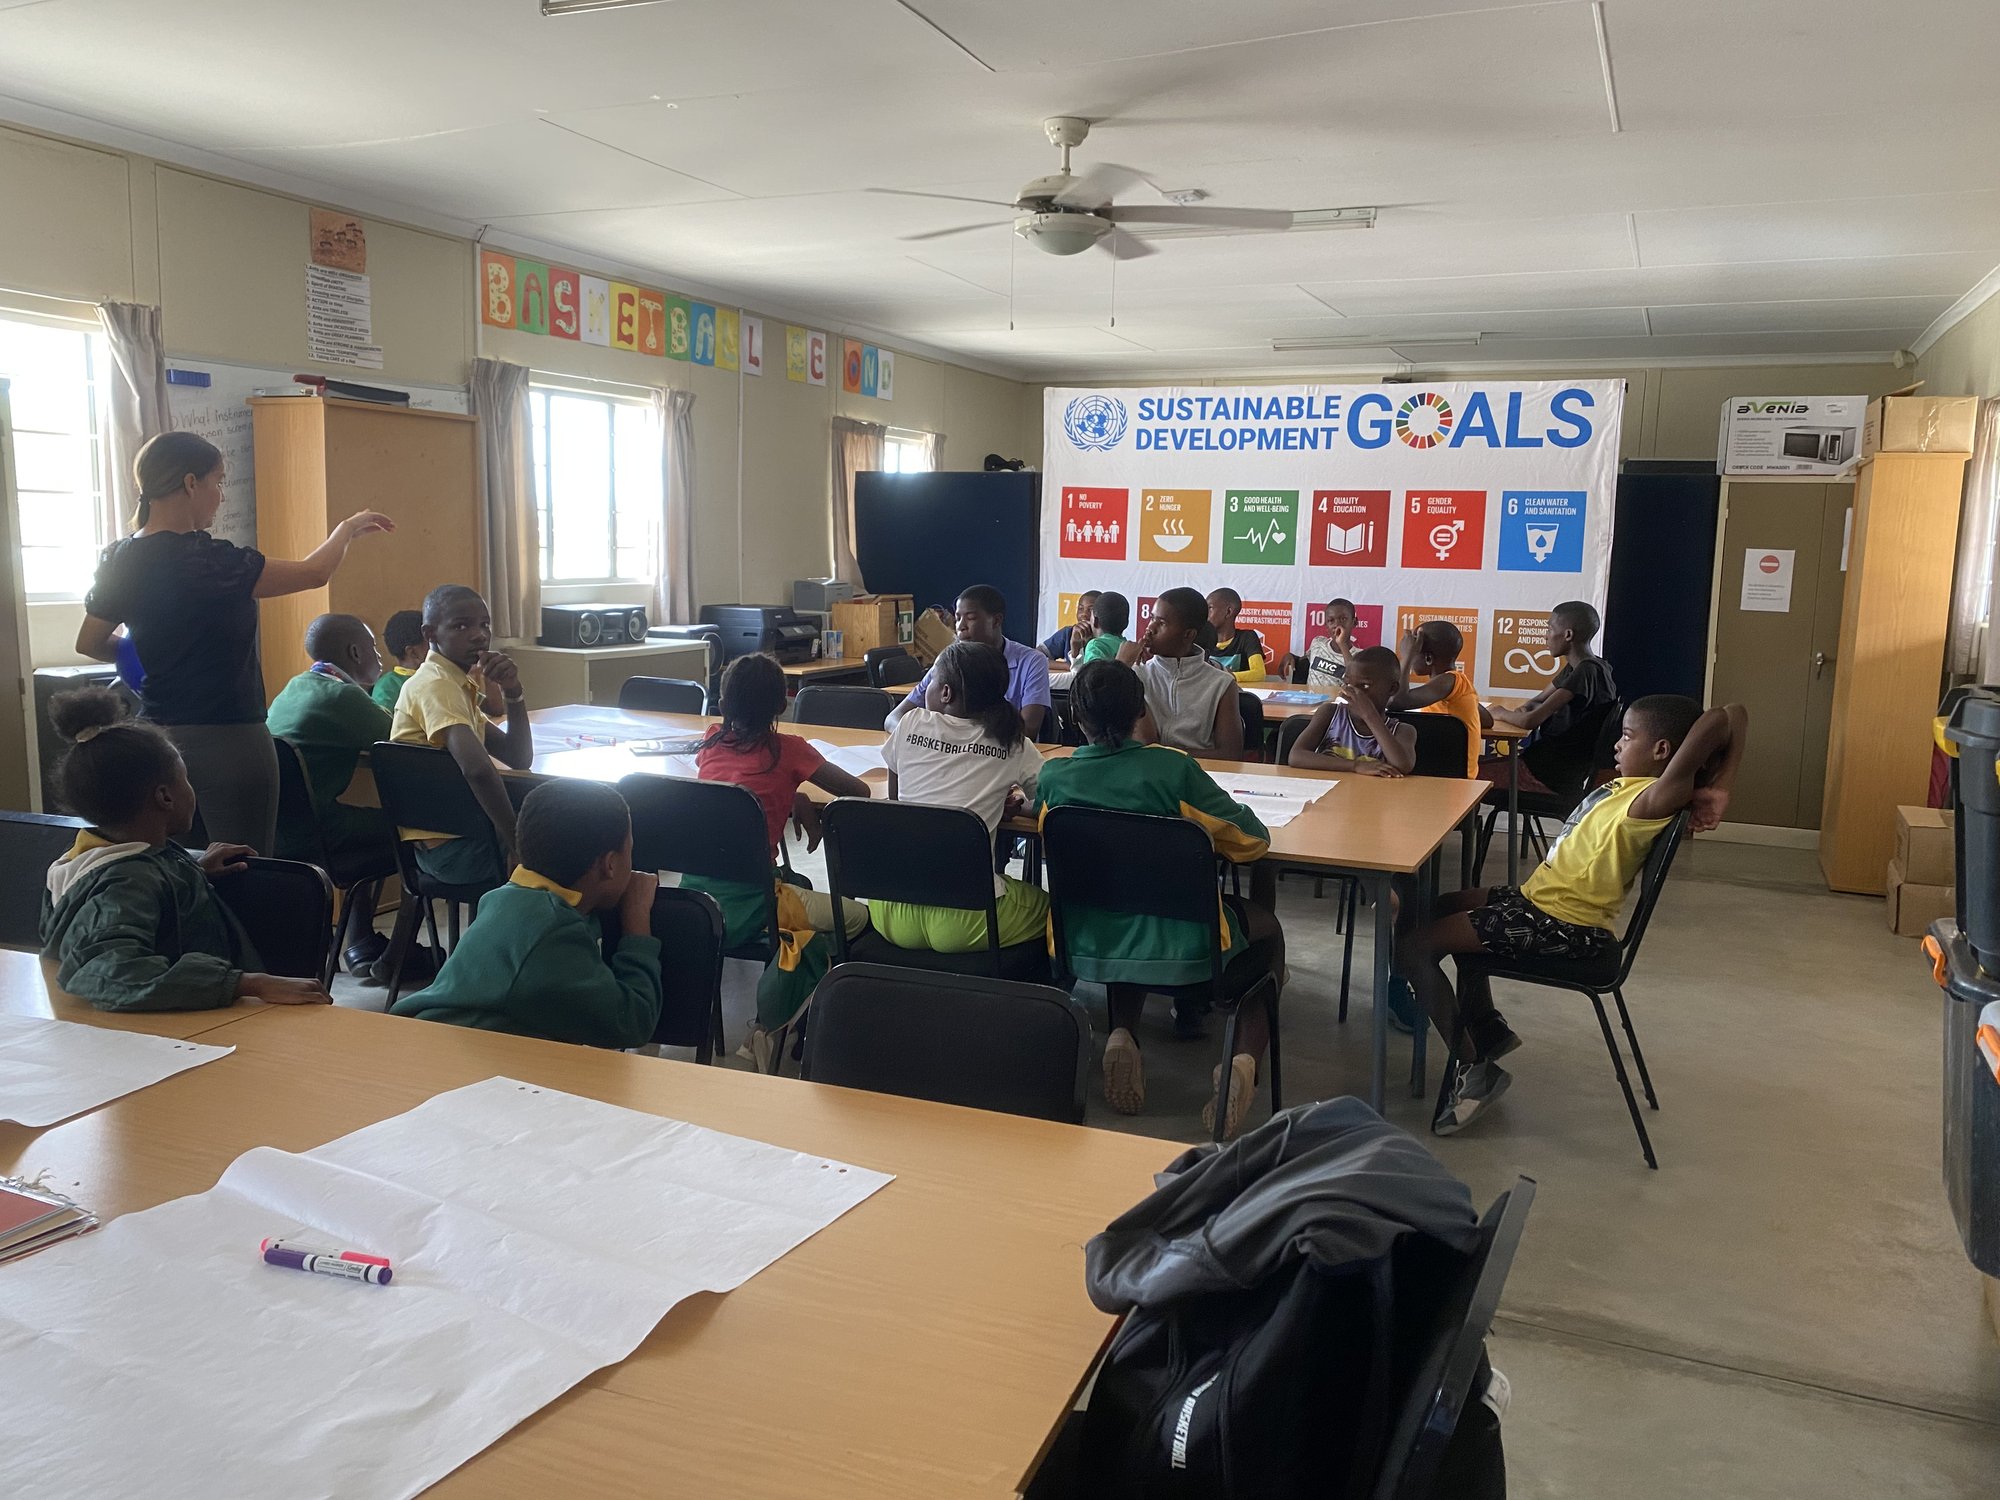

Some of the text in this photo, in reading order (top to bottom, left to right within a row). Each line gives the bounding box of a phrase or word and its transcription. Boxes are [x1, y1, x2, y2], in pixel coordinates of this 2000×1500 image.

[487, 262, 760, 368] BASKETBALL
[1138, 395, 1342, 421] SUSTAINABLE
[1347, 388, 1594, 450] GOALS
[1136, 427, 1339, 450] DEVELOPMENT
[1067, 493, 1073, 508] 1
[1078, 501, 1103, 510] POVERTY
[1145, 495, 1154, 511] 2
[1159, 504, 1181, 512] HUNGER
[1230, 497, 1239, 513] 3
[1318, 497, 1328, 513] 4
[1334, 497, 1359, 505] QUALITY
[1411, 497, 1421, 514] 5
[1428, 497, 1453, 505] GENDER
[1508, 498, 1518, 516] 6
[1546, 499, 1568, 507] WATER
[1256, 505, 1289, 513] WELL-BEING
[1333, 505, 1366, 513] EDUCATION
[1427, 506, 1457, 515] EQUALITY
[1538, 507, 1577, 516] SANITATION
[1063, 600, 1070, 614] 7
[1141, 604, 1149, 618] 8
[1246, 617, 1291, 625] INFRASTRUCTURE
[1310, 610, 1325, 626] 10
[1402, 613, 1414, 630] 11
[1419, 614, 1459, 623] SUSTAINABLE
[1498, 617, 1513, 634] 12
[1318, 660, 1337, 671] NYC
[906, 734, 1007, 760] #BASKETBALLFORGOOD
[1172, 1396, 1196, 1469] BASKETBALL
